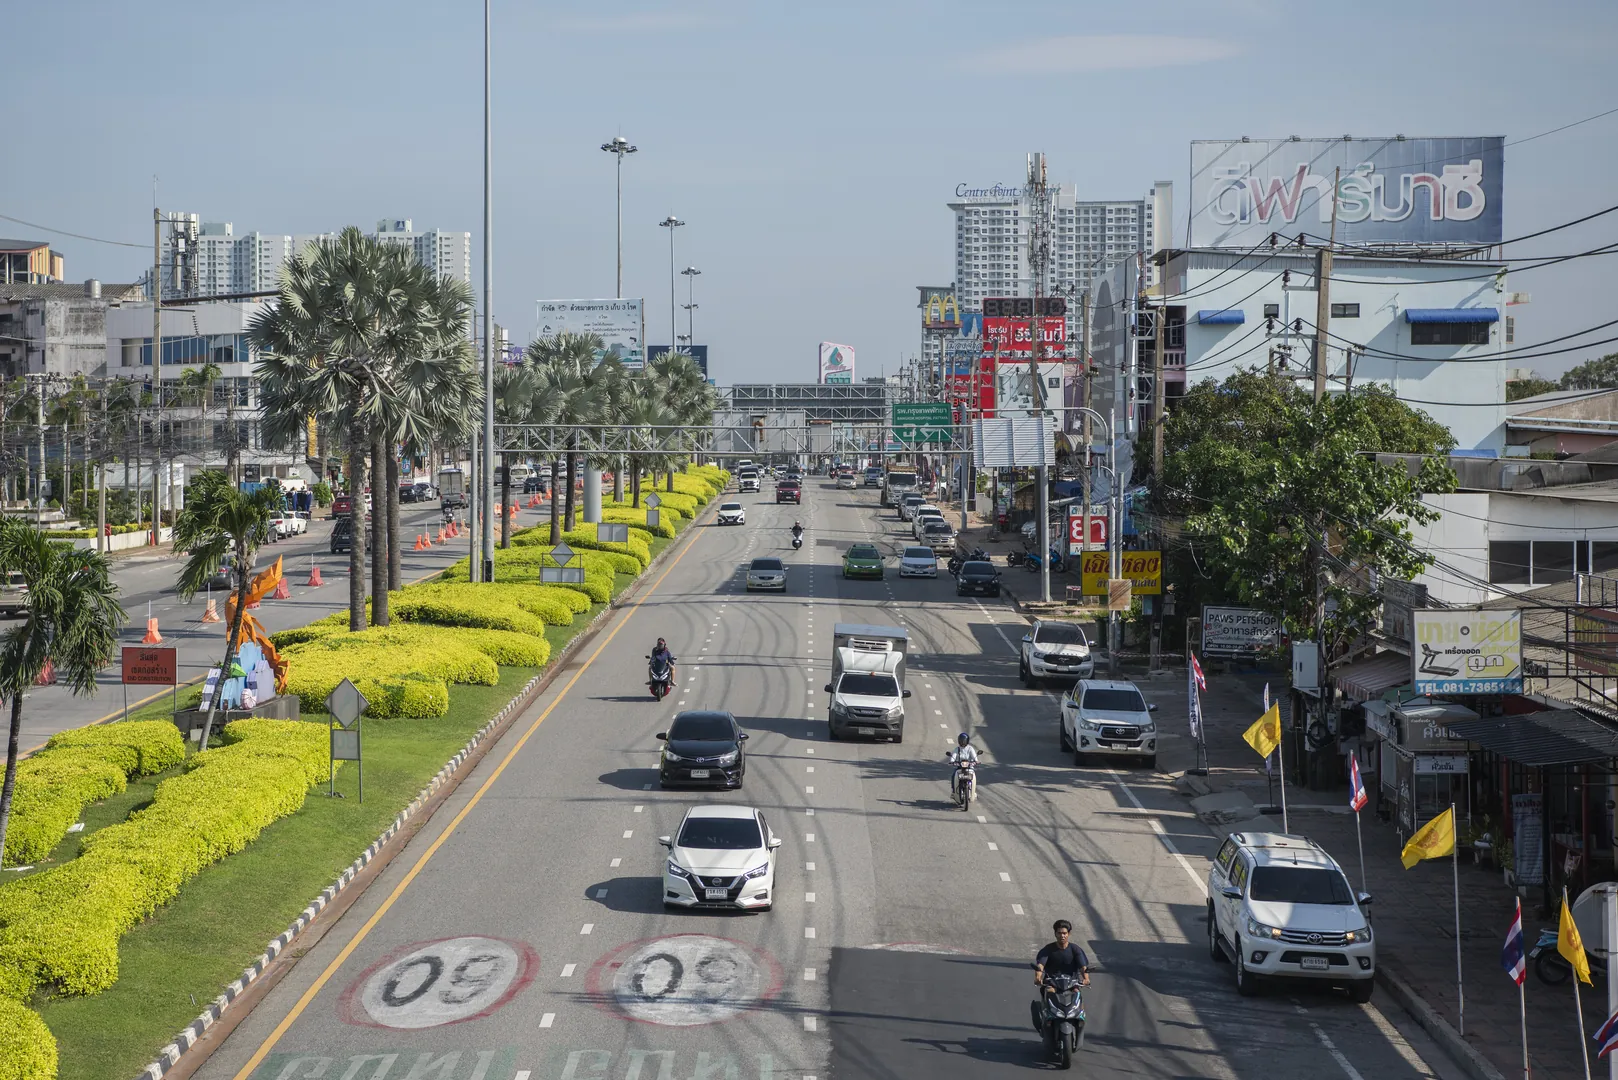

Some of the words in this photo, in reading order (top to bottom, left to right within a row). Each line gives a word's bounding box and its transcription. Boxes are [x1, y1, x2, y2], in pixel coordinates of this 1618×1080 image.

[955, 182, 989, 198] Centre
[989, 182, 1022, 198] Point
[627, 302, 637, 310] โรค
[897, 406, 948, 416] รพ.กรุงเทพพัทยา
[1209, 614, 1234, 624] PAWS
[1236, 615, 1277, 625] PETSHOP
[1417, 621, 1459, 643] ขาย
[1470, 614, 1519, 643] ซ่อม
[1467, 654, 1504, 672] ถูก
[131, 664, 168, 674] เขตก่อสร้าง
